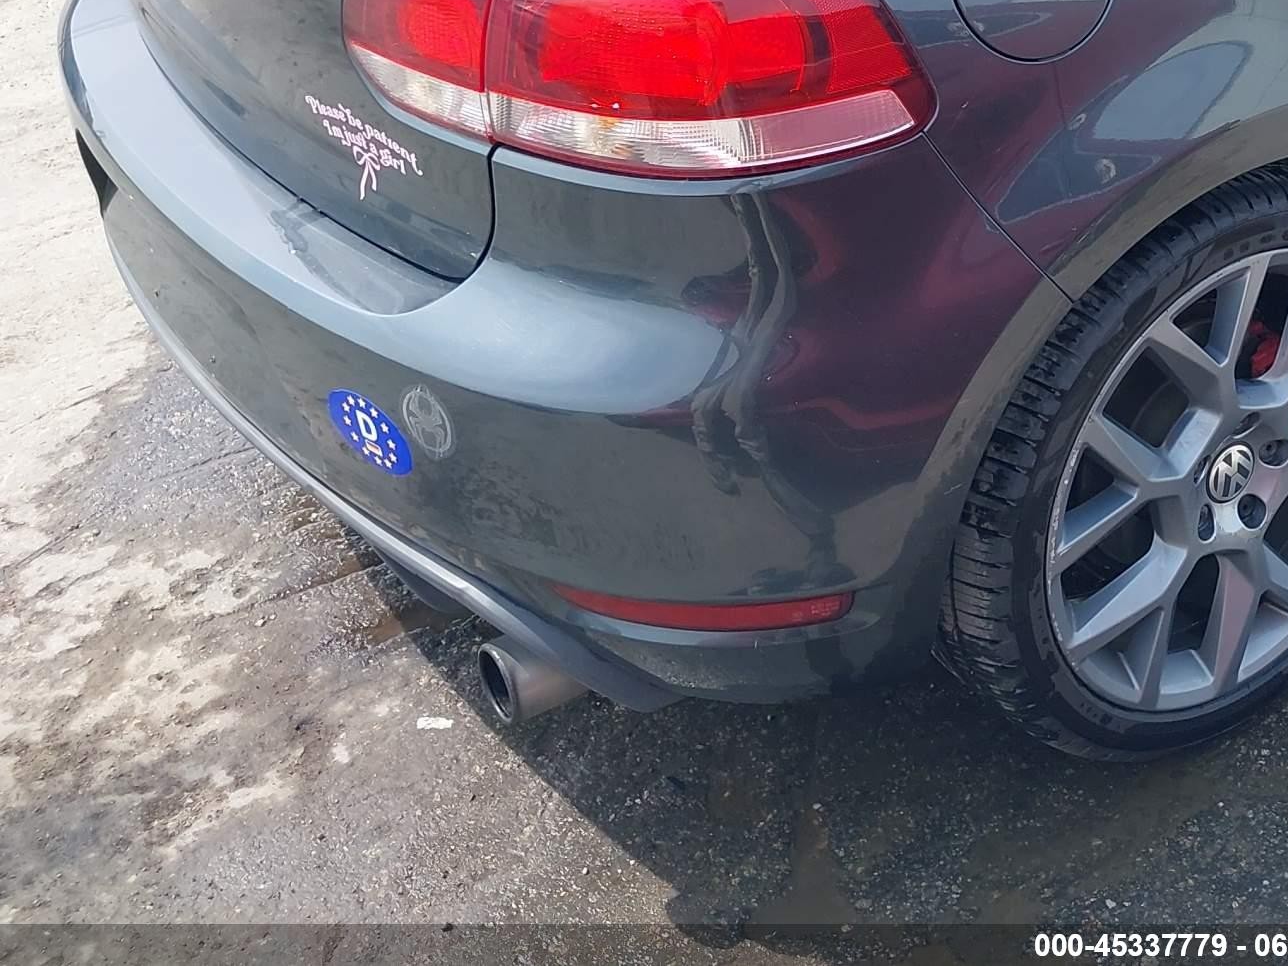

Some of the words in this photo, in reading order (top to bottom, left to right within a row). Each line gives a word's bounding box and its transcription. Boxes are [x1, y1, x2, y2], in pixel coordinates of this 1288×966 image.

[304, 95, 347, 122] Please
[338, 103, 363, 130] be
[362, 124, 424, 176] patient
[342, 125, 368, 149] just
[370, 142, 379, 157] a
[379, 149, 407, 176] girl
[355, 409, 378, 443] D
